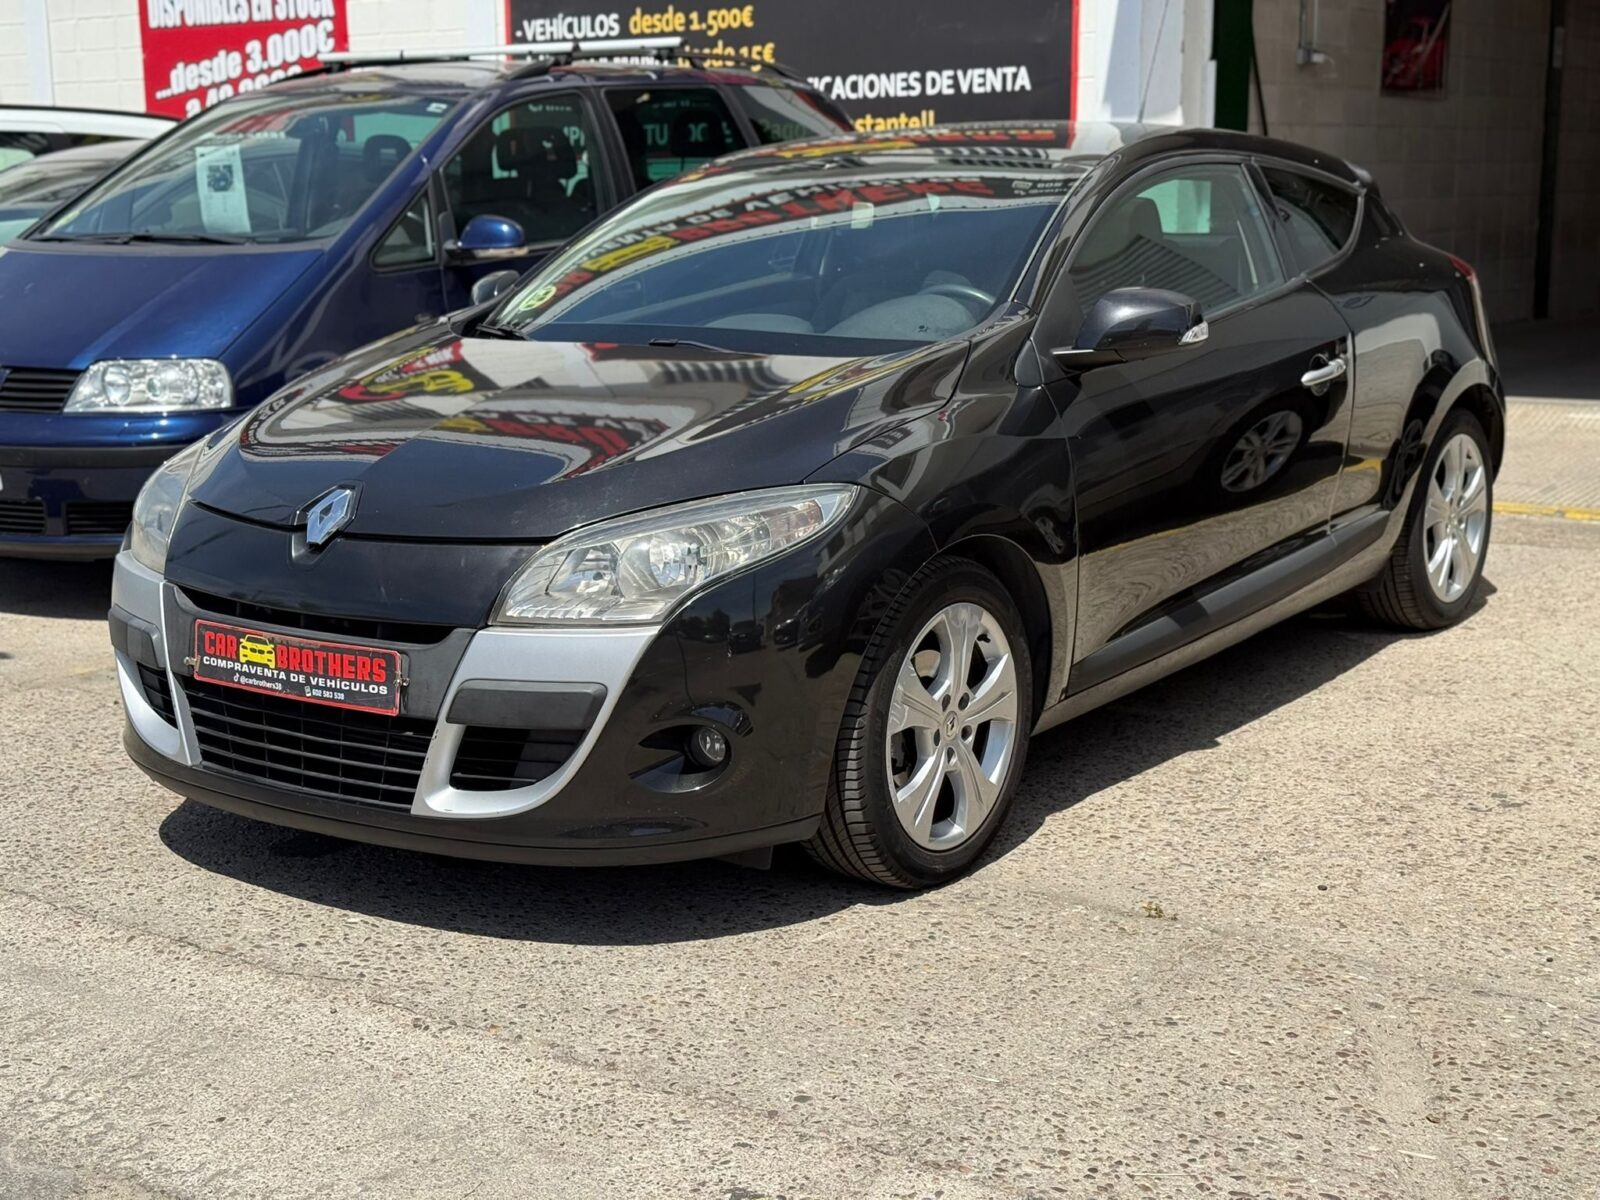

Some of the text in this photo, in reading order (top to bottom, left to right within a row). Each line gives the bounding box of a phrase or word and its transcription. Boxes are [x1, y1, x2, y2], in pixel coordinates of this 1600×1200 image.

[629, 6, 686, 35] desde
[689, 4, 754, 37] 1.500€
[245, 19, 335, 74] 3.000€
[925, 70, 955, 96] DE
[957, 65, 1032, 95] VENTA
[203, 656, 389, 695] COMPRAVENTA DE VEHÍCULOS
[204, 630, 387, 683] CAR BROTHERS
